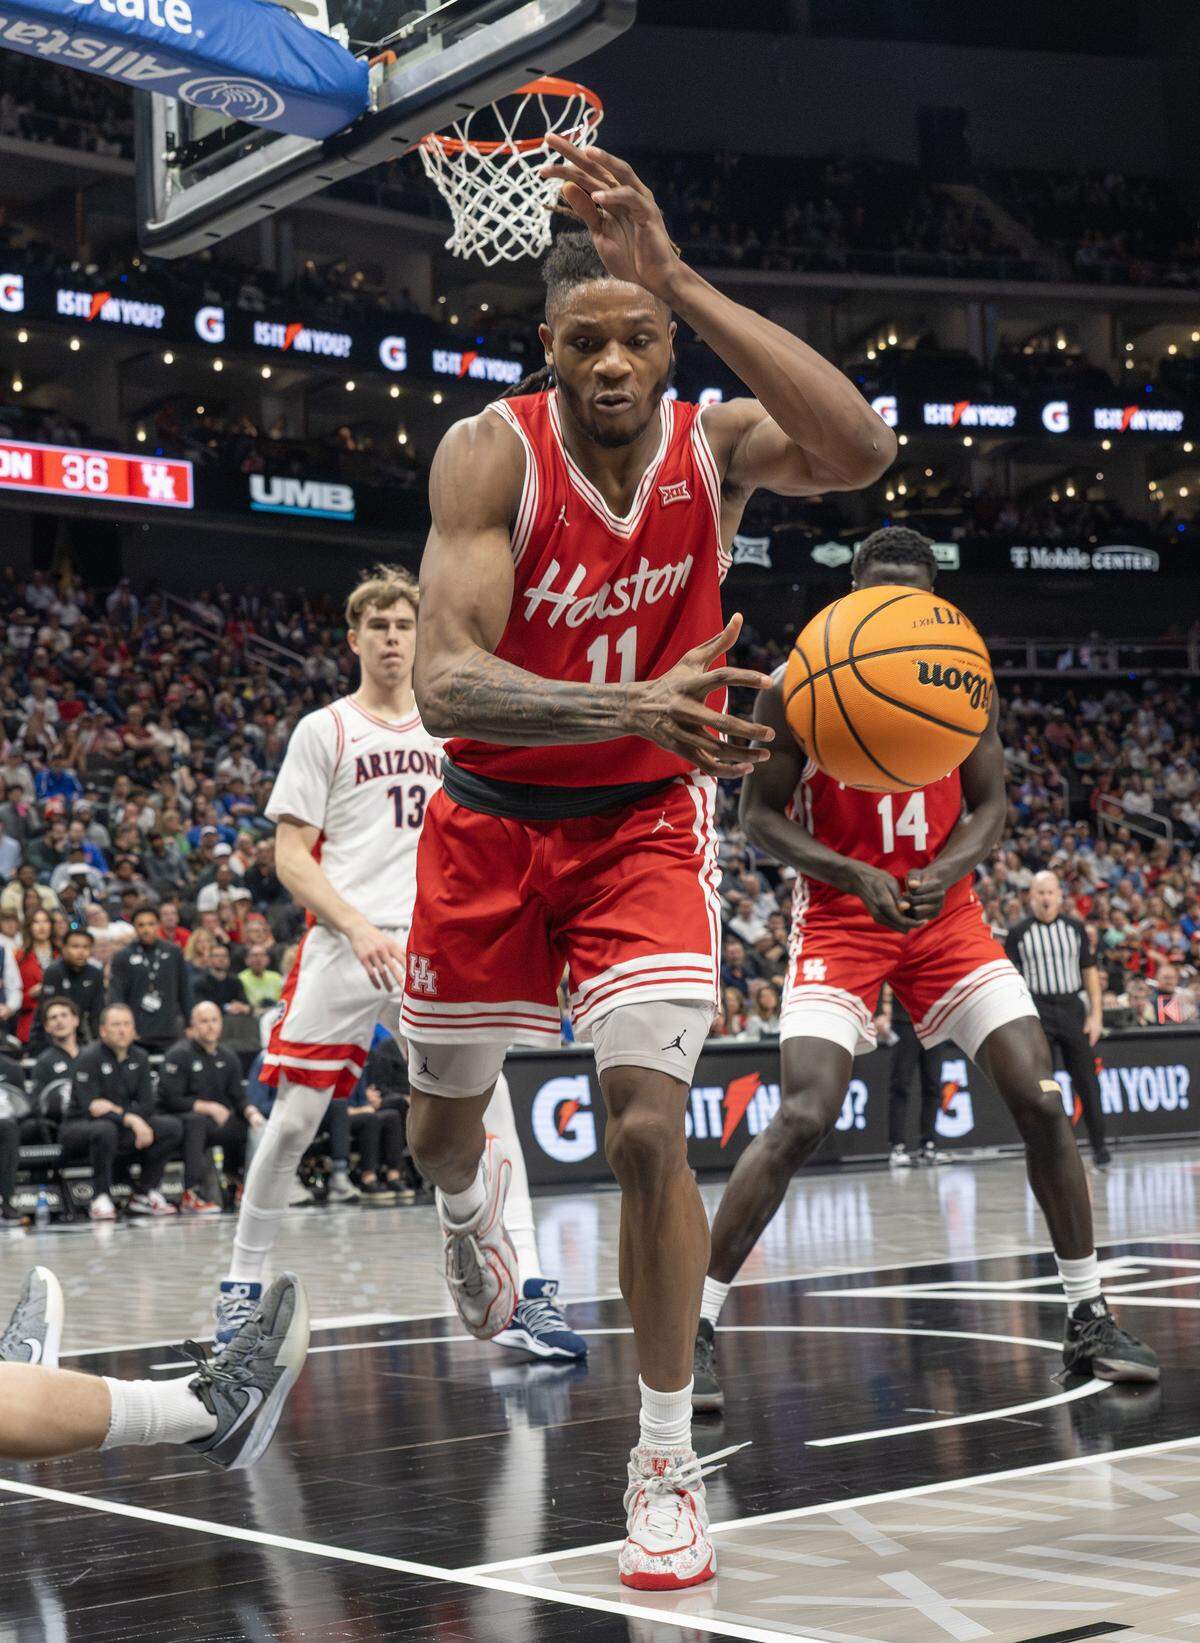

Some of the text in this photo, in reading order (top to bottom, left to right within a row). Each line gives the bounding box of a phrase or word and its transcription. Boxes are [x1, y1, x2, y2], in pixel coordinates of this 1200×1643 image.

[0, 17, 192, 81] Allsta
[0, 273, 24, 312] G
[195, 306, 225, 343] G
[379, 336, 407, 371] G
[1042, 401, 1070, 433] G
[61, 454, 109, 493] 36
[249, 474, 355, 513] UMB
[1092, 552, 1155, 570] CENTER
[523, 553, 694, 628] Houston
[587, 625, 638, 684] 11
[353, 750, 444, 787] ARIZON
[386, 784, 426, 829] 13
[876, 791, 929, 854] 14
[1119, 1065, 1190, 1112] YOU?
[531, 1073, 597, 1163] G
